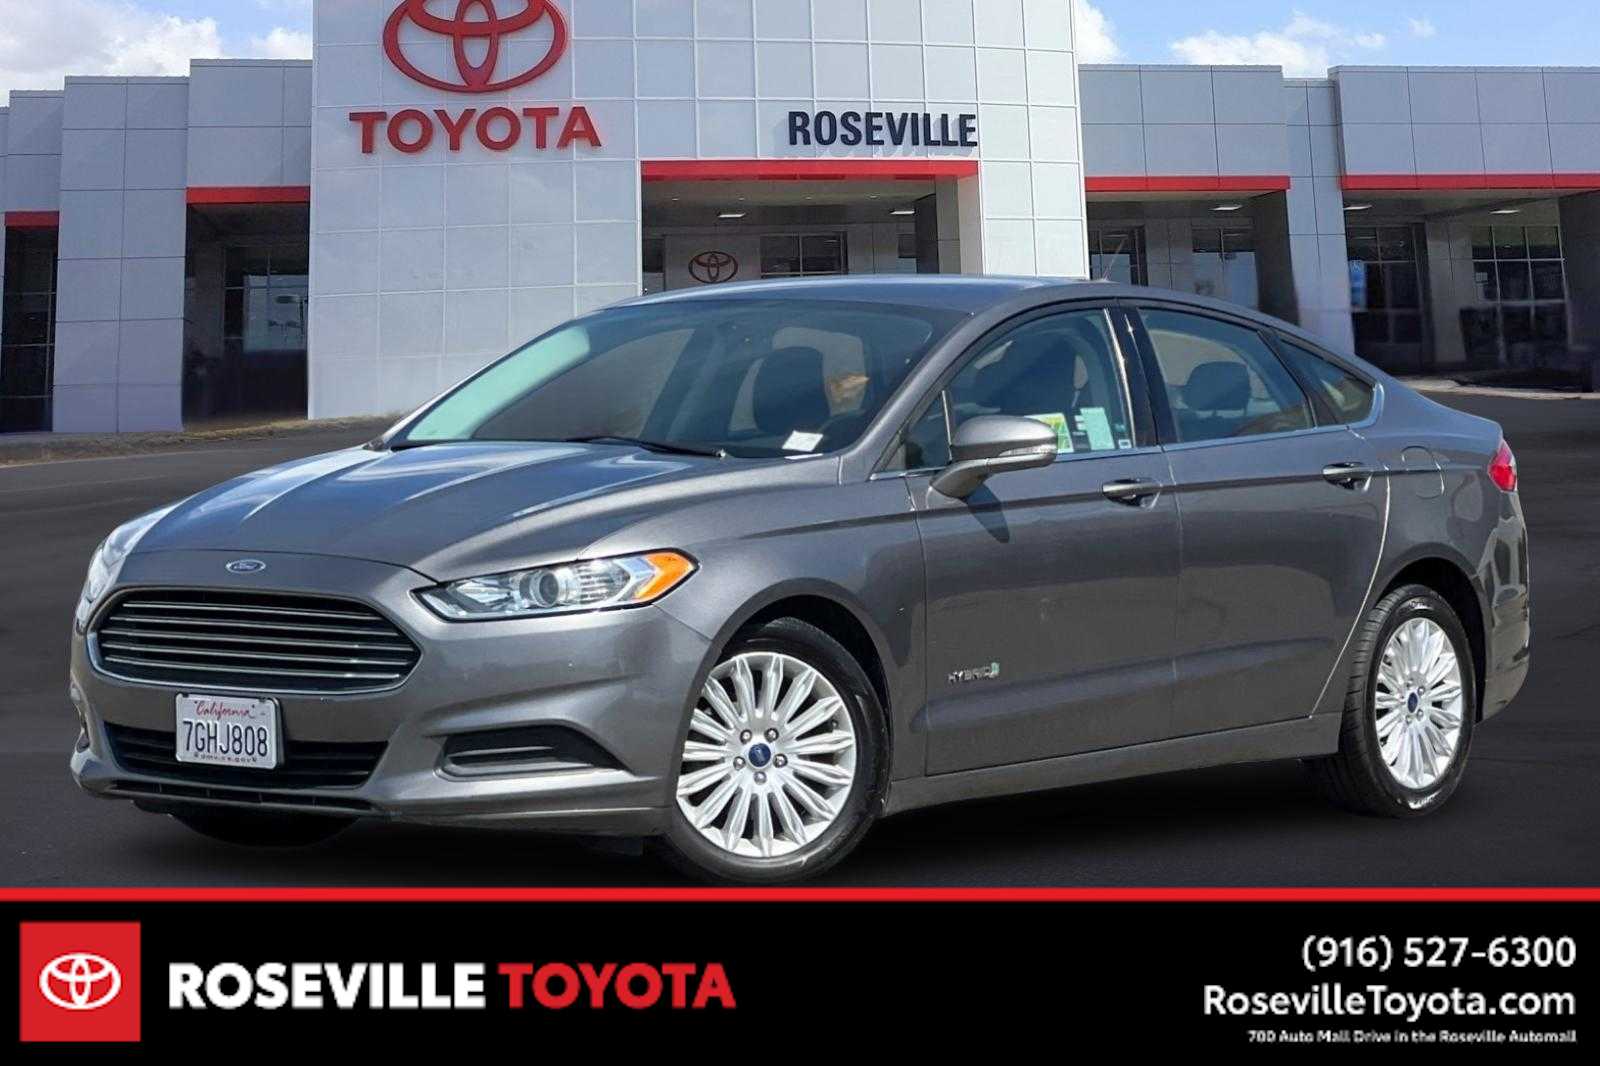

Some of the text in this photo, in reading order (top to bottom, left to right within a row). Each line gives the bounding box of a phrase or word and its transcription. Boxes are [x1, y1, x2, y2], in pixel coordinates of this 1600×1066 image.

[349, 106, 602, 154] TOYOTA
[788, 111, 978, 147] ROSEVILLE
[196, 701, 252, 720] California
[183, 721, 267, 757] 7GHJ808
